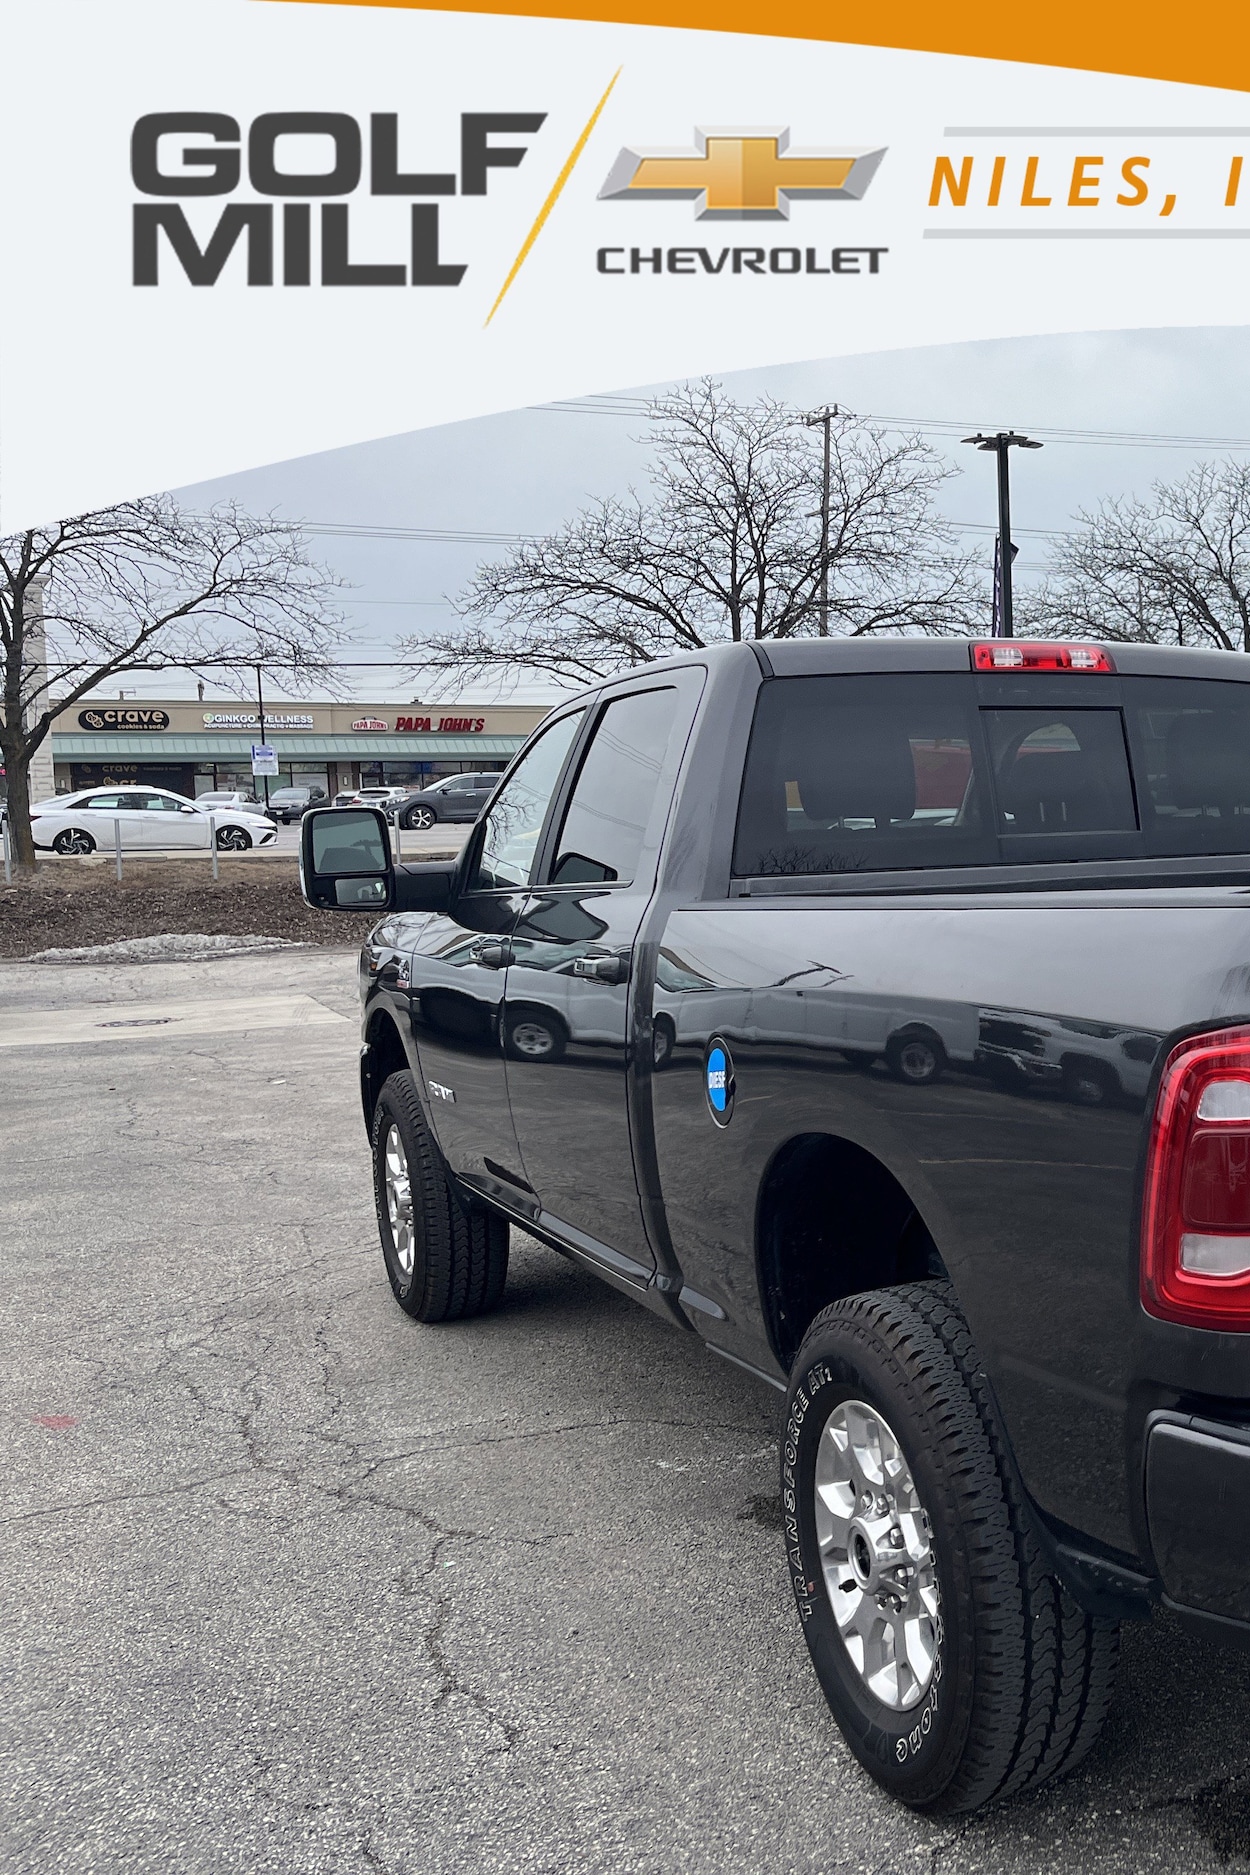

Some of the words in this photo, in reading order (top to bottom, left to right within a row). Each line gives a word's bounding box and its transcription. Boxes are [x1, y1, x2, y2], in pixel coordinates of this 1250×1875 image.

[103, 710, 164, 723] crave
[214, 714, 256, 723] GINKGO
[353, 720, 368, 729] PAPA
[395, 717, 431, 731] PAPA
[437, 717, 485, 731] JOHN'S
[102, 764, 138, 772] crave
[781, 1387, 815, 1622] TRANSFORCE
